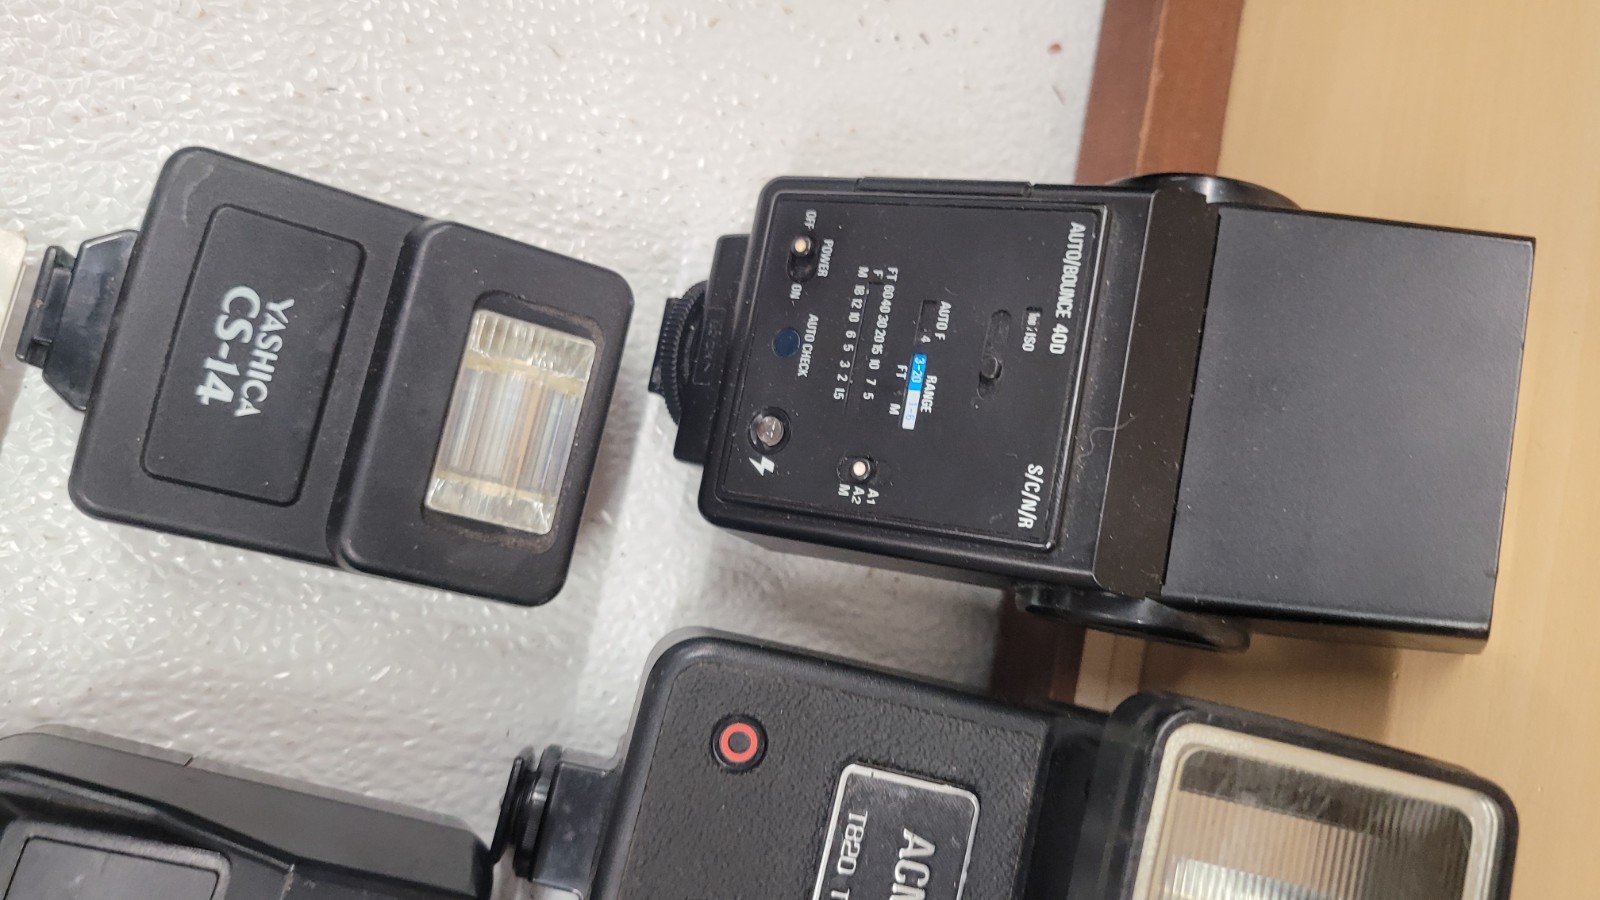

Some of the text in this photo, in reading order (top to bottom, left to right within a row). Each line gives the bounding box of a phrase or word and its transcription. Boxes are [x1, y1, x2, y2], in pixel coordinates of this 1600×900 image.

[803, 209, 818, 231] OFF
[817, 238, 835, 278] POWER
[857, 266, 870, 279] M
[872, 269, 884, 280] F
[789, 283, 802, 300] ON
[853, 284, 866, 296] 18
[1050, 221, 1086, 355] AUTO/BOUNCE 40D
[851, 298, 863, 310] 12
[848, 312, 861, 323] 10
[934, 301, 952, 341] AUTO F
[845, 330, 857, 339] 6
[863, 267, 899, 401] FT 60 40 30 20 15 10 7 5
[921, 335, 931, 343] 4
[195, 286, 260, 405] CS-14
[797, 313, 819, 378] AUTO CHECK
[842, 343, 855, 352] 5
[234, 299, 294, 416] YASHICA
[839, 359, 851, 369] 3
[836, 374, 849, 382] 2
[895, 364, 908, 380] FT
[911, 357, 926, 384] 3-20
[920, 374, 938, 414] RANGE
[888, 402, 901, 416] M
[837, 483, 850, 497] M
[851, 485, 865, 506] A2
[866, 487, 880, 505] A1
[1017, 463, 1044, 529] S/C/N/R
